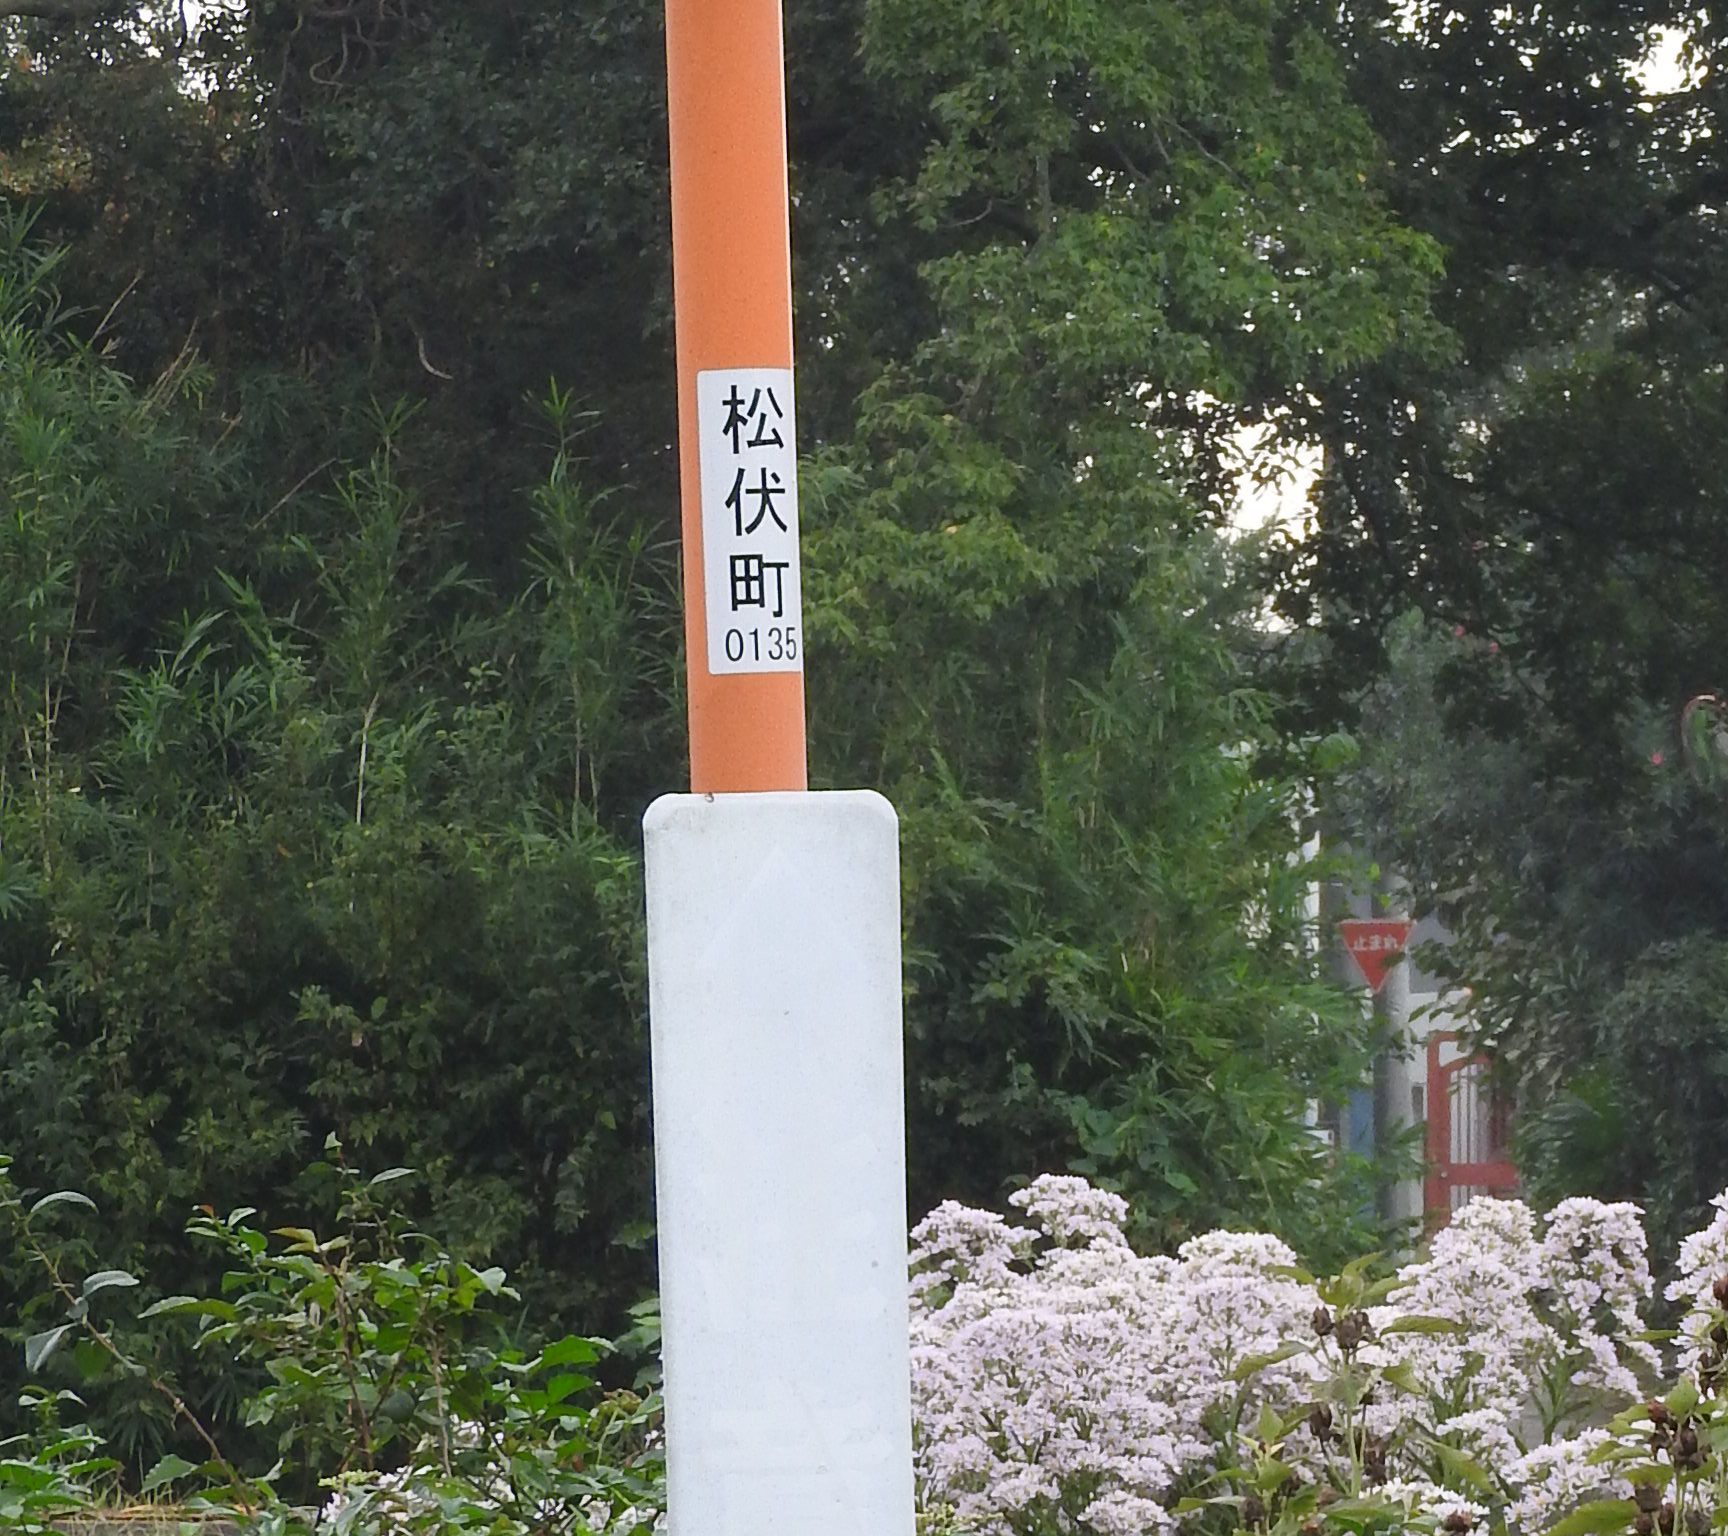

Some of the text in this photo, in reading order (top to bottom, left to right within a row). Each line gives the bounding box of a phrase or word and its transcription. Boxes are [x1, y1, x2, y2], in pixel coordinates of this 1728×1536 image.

[721, 384, 789, 619] 松伏町
[725, 626, 797, 662] 0135
